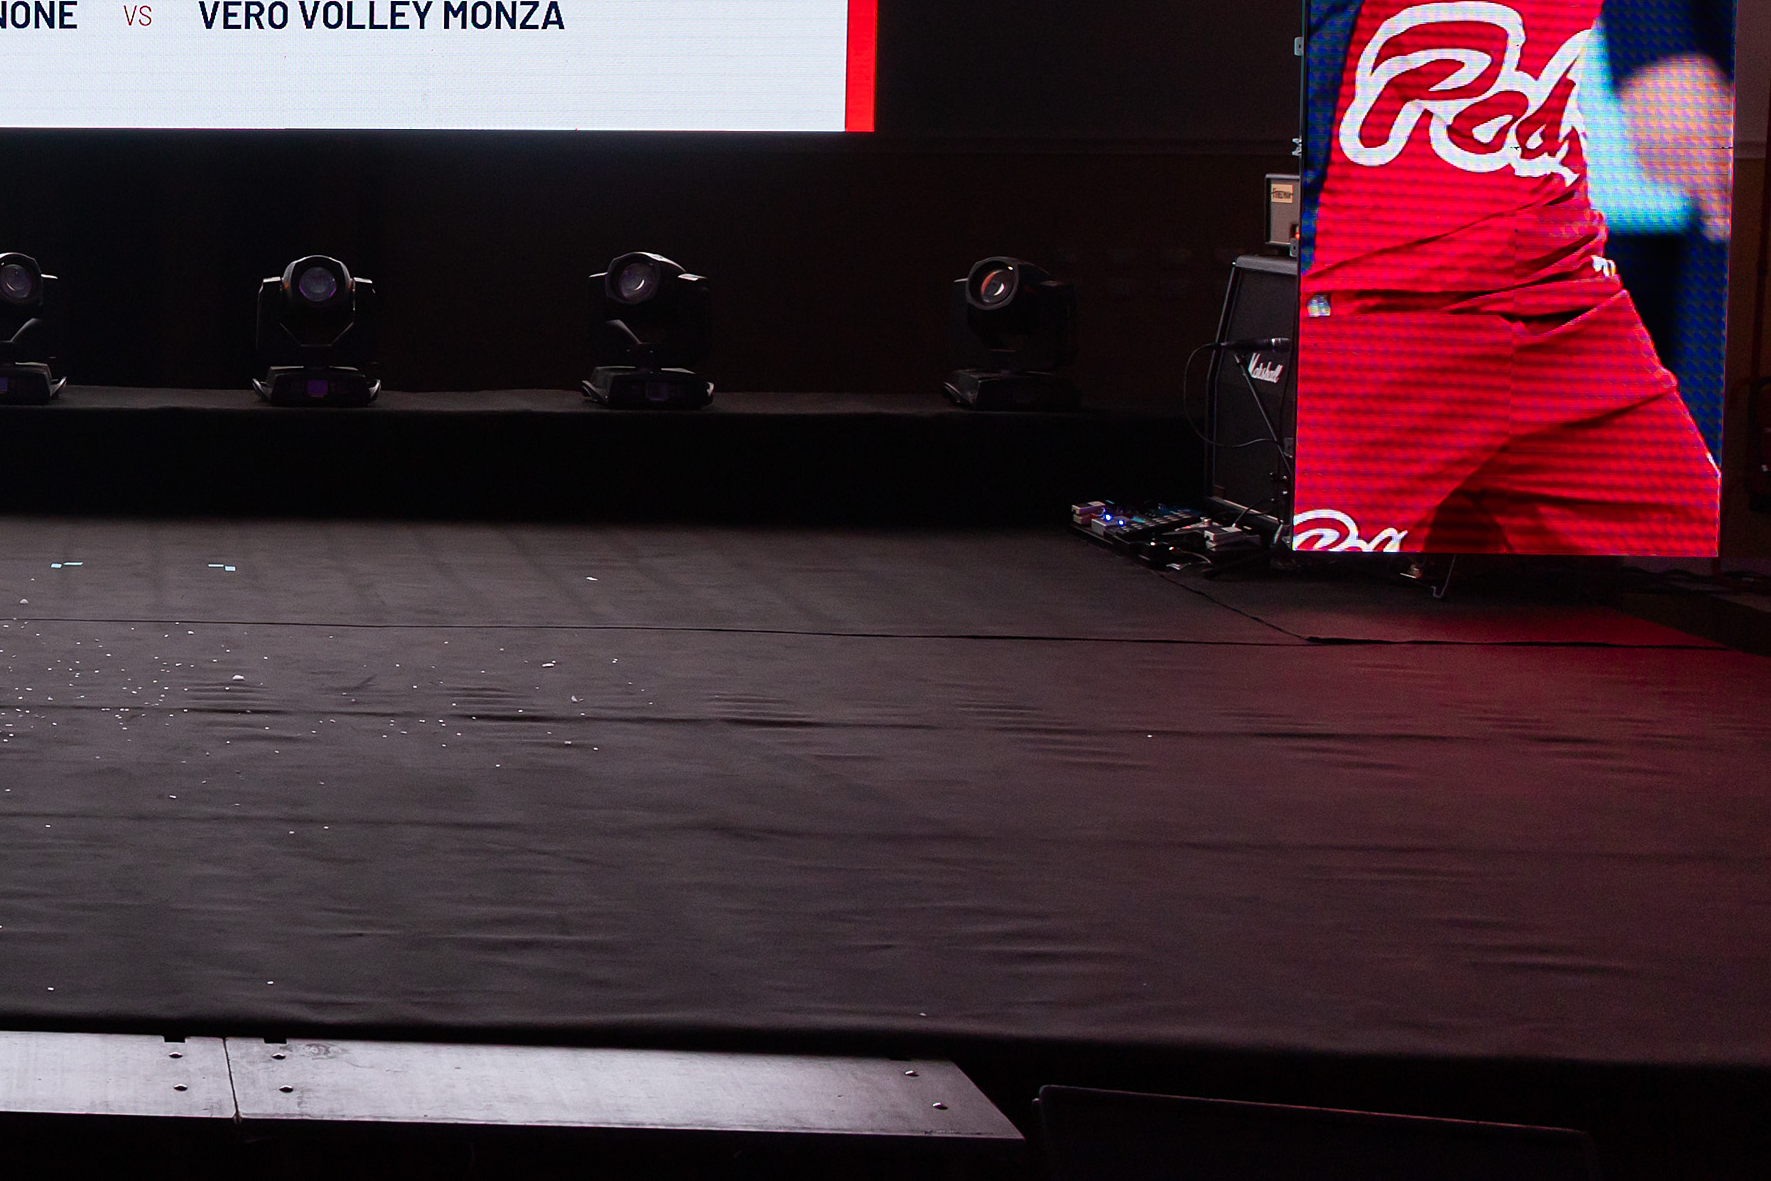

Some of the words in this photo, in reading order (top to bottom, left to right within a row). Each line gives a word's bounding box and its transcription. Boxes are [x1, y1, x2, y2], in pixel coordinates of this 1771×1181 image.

[124, 5, 152, 26] VS
[199, 1, 288, 29] VERO
[298, 1, 433, 29] VOLLEY
[444, 1, 564, 29] MONZA
